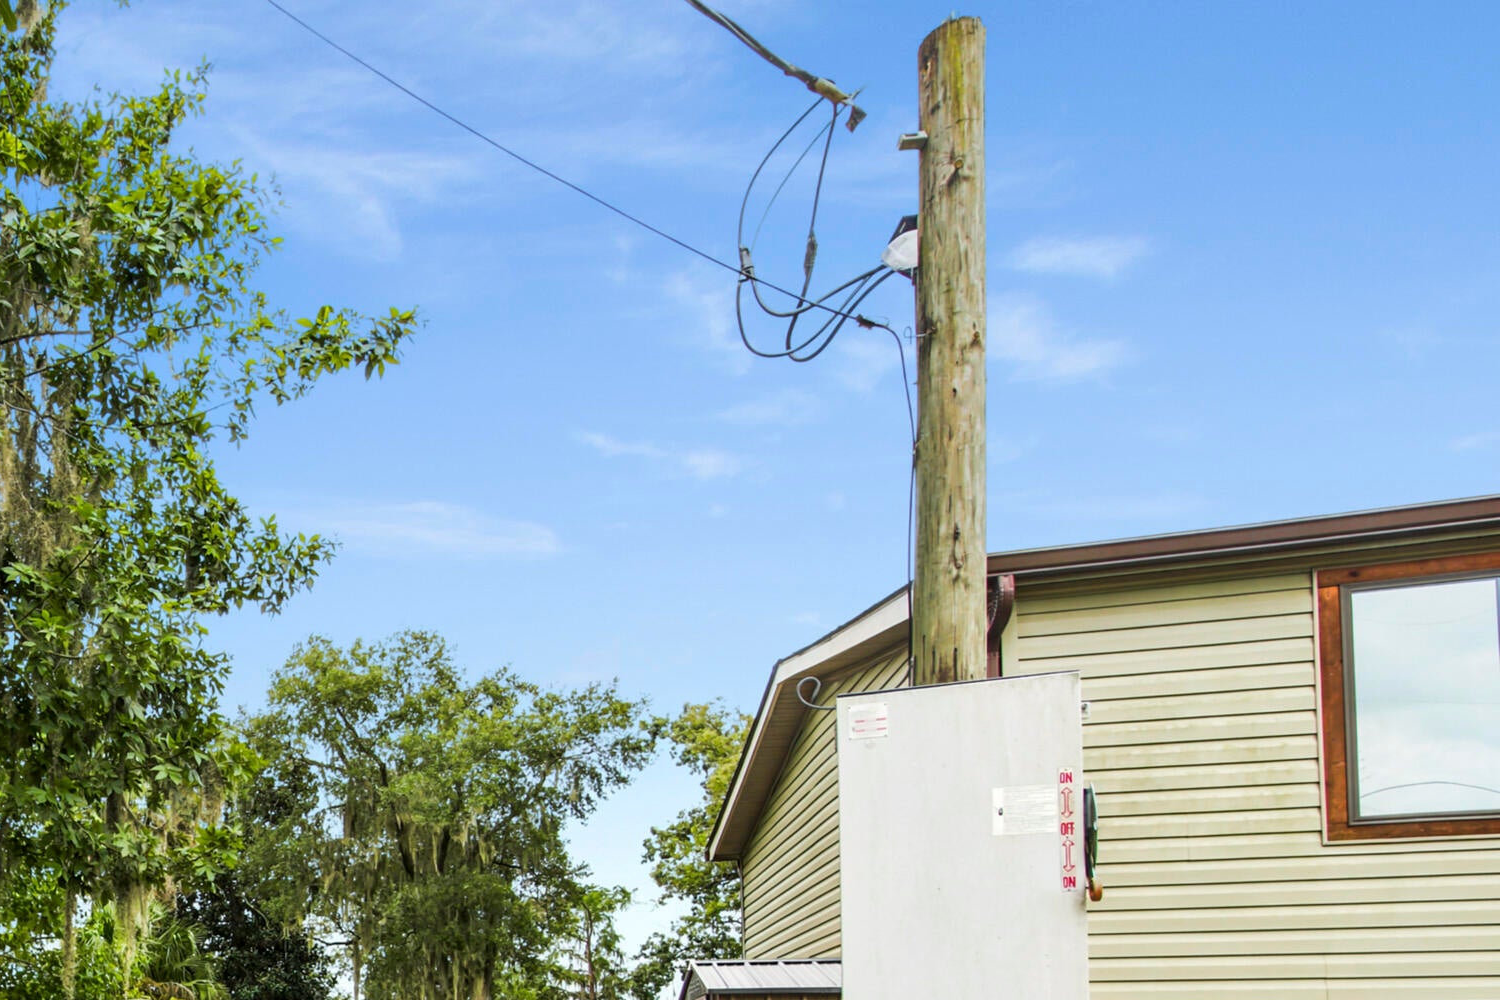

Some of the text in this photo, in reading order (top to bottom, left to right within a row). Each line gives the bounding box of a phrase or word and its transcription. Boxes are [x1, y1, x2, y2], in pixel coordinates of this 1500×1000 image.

[1060, 772, 1072, 783] ON
[1061, 822, 1074, 835] OFF
[1063, 876, 1076, 888] ON
